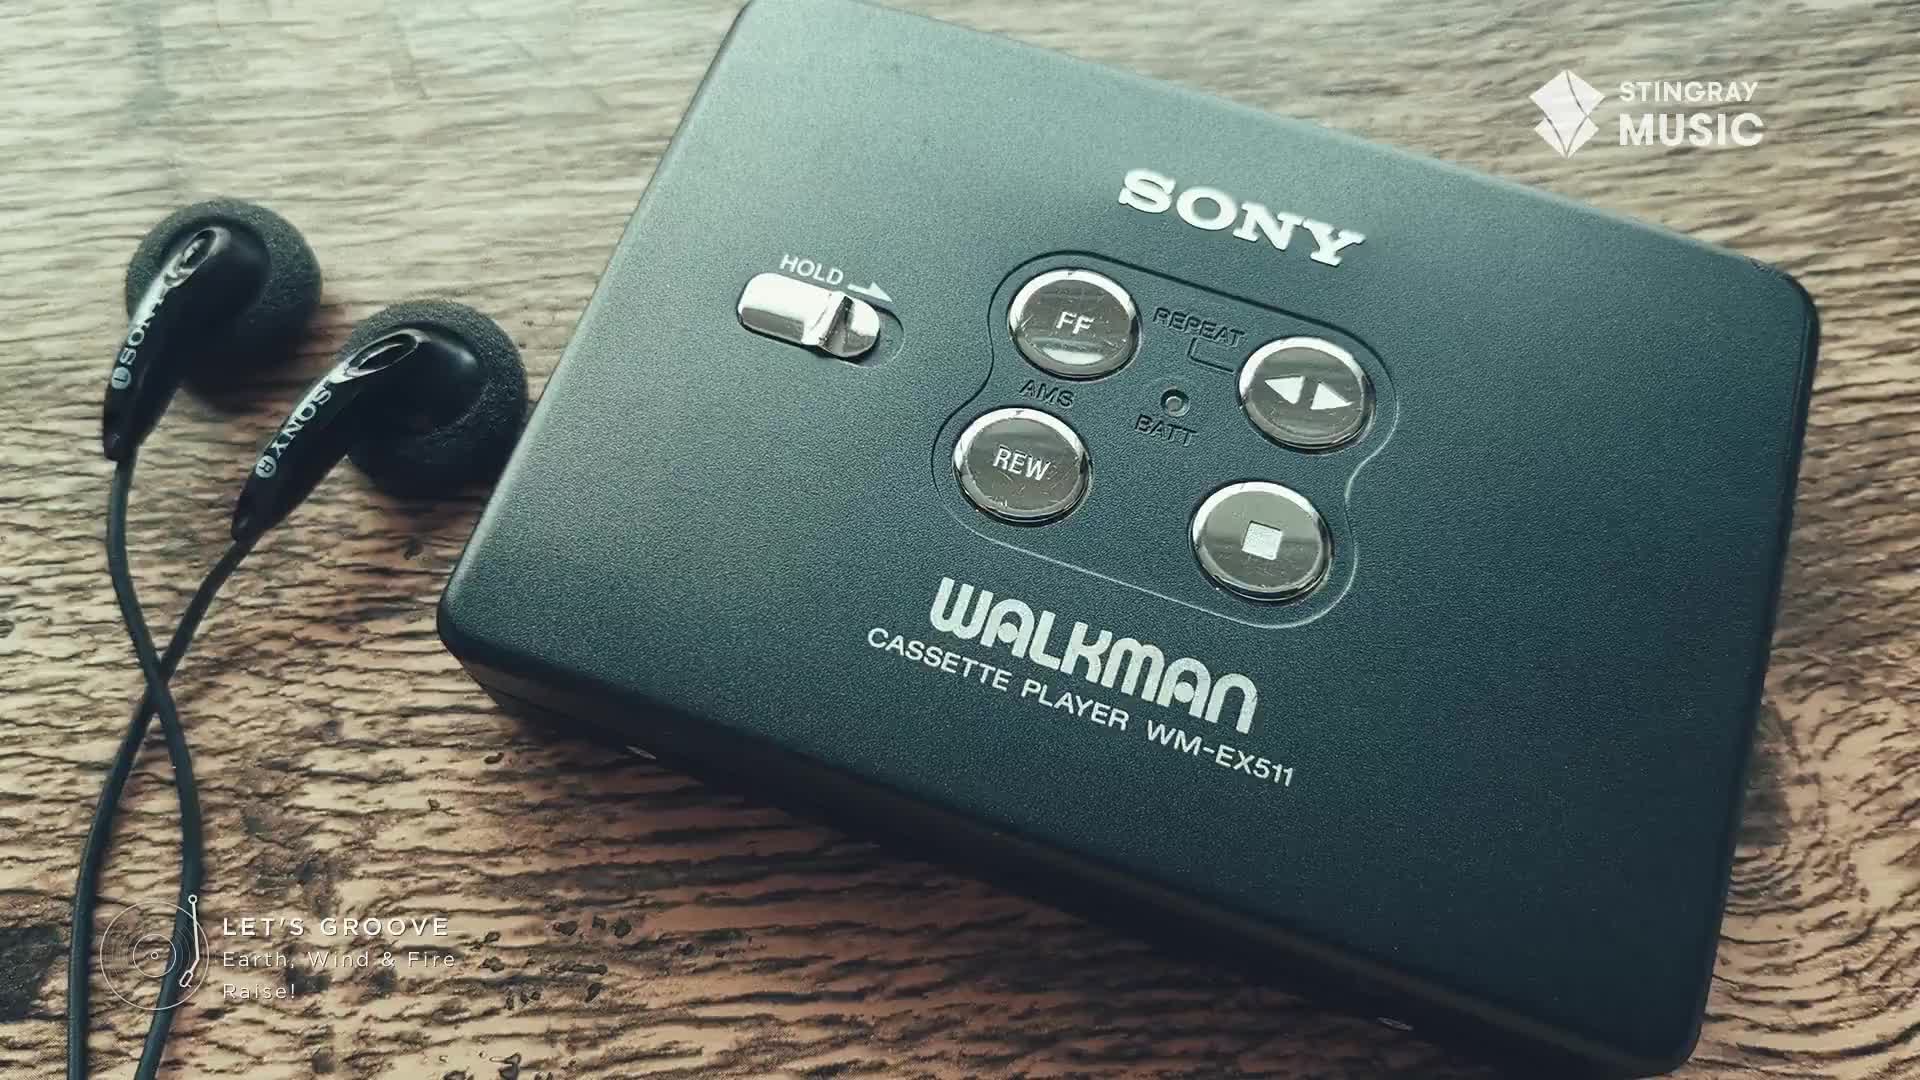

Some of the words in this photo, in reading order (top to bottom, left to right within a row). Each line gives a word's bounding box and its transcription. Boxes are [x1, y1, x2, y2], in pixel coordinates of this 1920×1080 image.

[1118, 168, 1367, 267] SONY
[779, 254, 844, 285] HOLD
[1055, 310, 1095, 335] FF
[1153, 306, 1245, 348] REPEAT
[1019, 379, 1075, 408] AMS
[271, 385, 332, 460] SONY
[1135, 414, 1197, 447] BATT
[992, 446, 1051, 481] REW
[930, 577, 1258, 734] WALKMAN
[868, 627, 1012, 691] CASSETTE
[1021, 678, 1130, 731] PLAYER
[1147, 719, 1294, 787] WM-EX511
